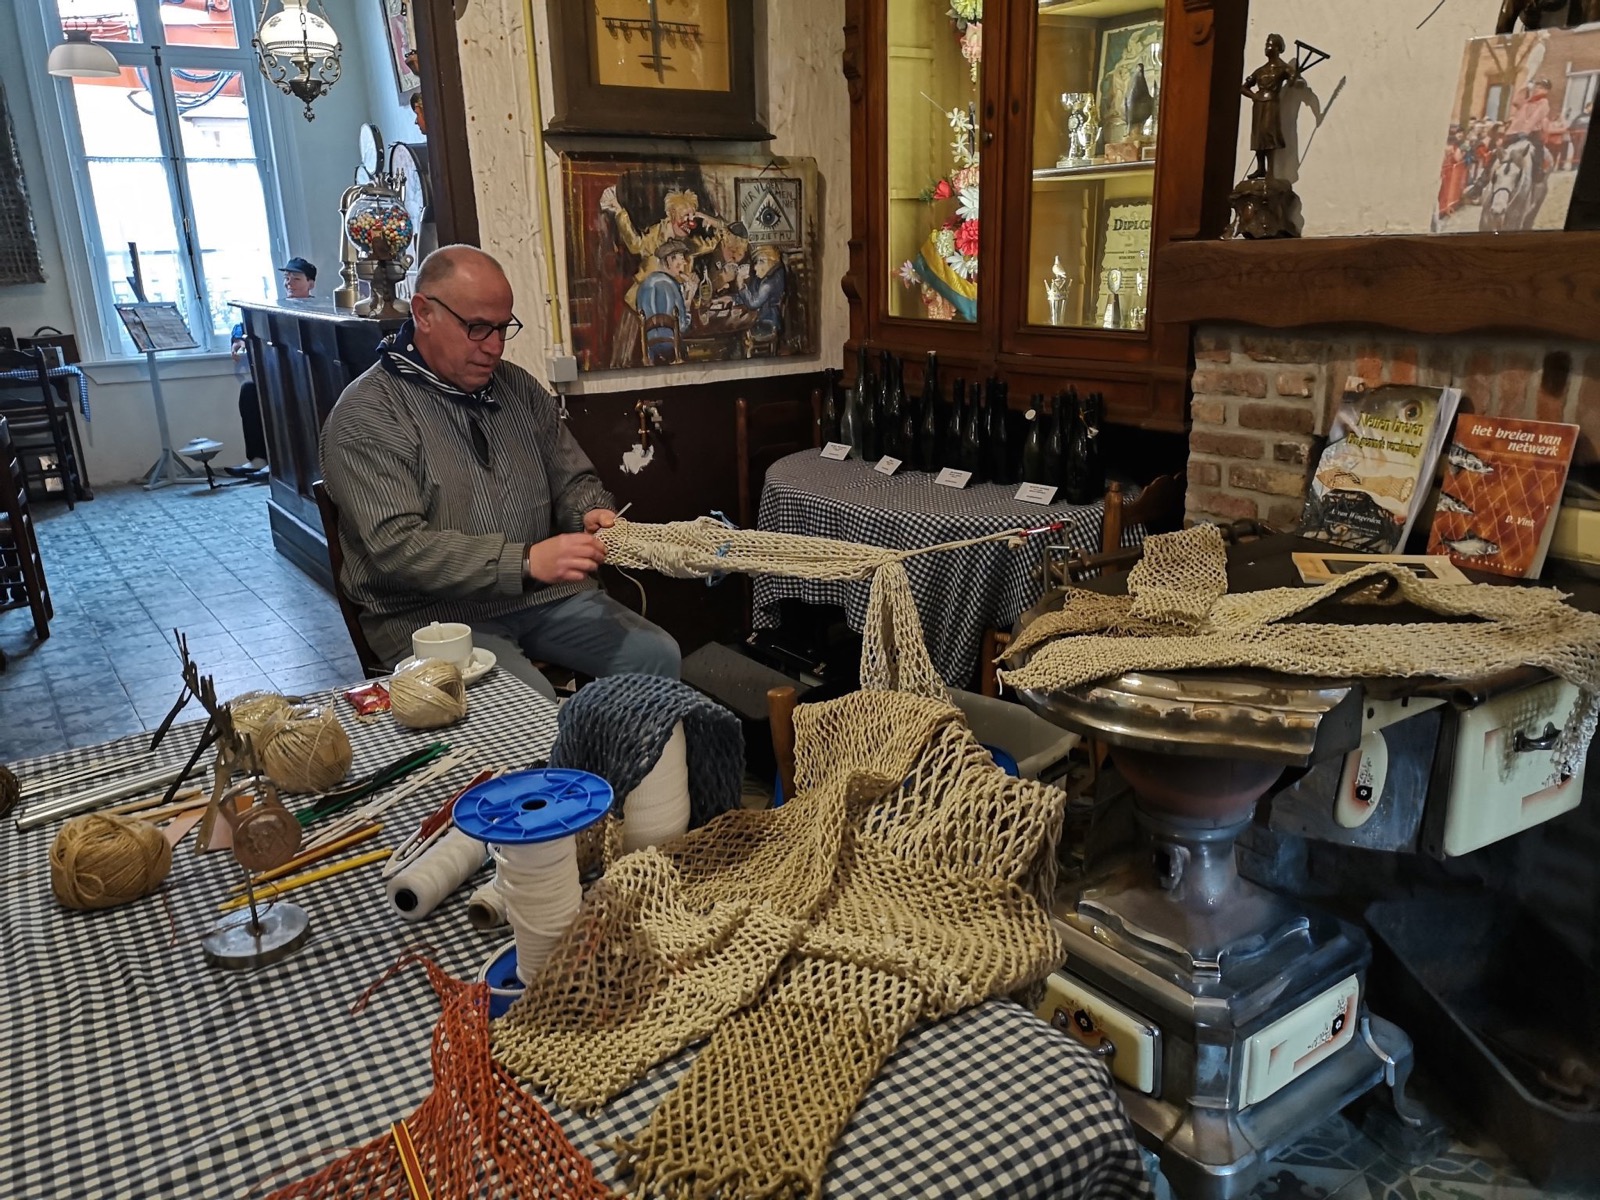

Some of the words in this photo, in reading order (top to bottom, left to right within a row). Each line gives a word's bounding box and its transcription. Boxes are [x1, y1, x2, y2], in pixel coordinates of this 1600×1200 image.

[1471, 424, 1493, 437] Het
[1495, 427, 1536, 442] breien
[1538, 434, 1562, 445] van
[1507, 441, 1559, 456] netwerk
